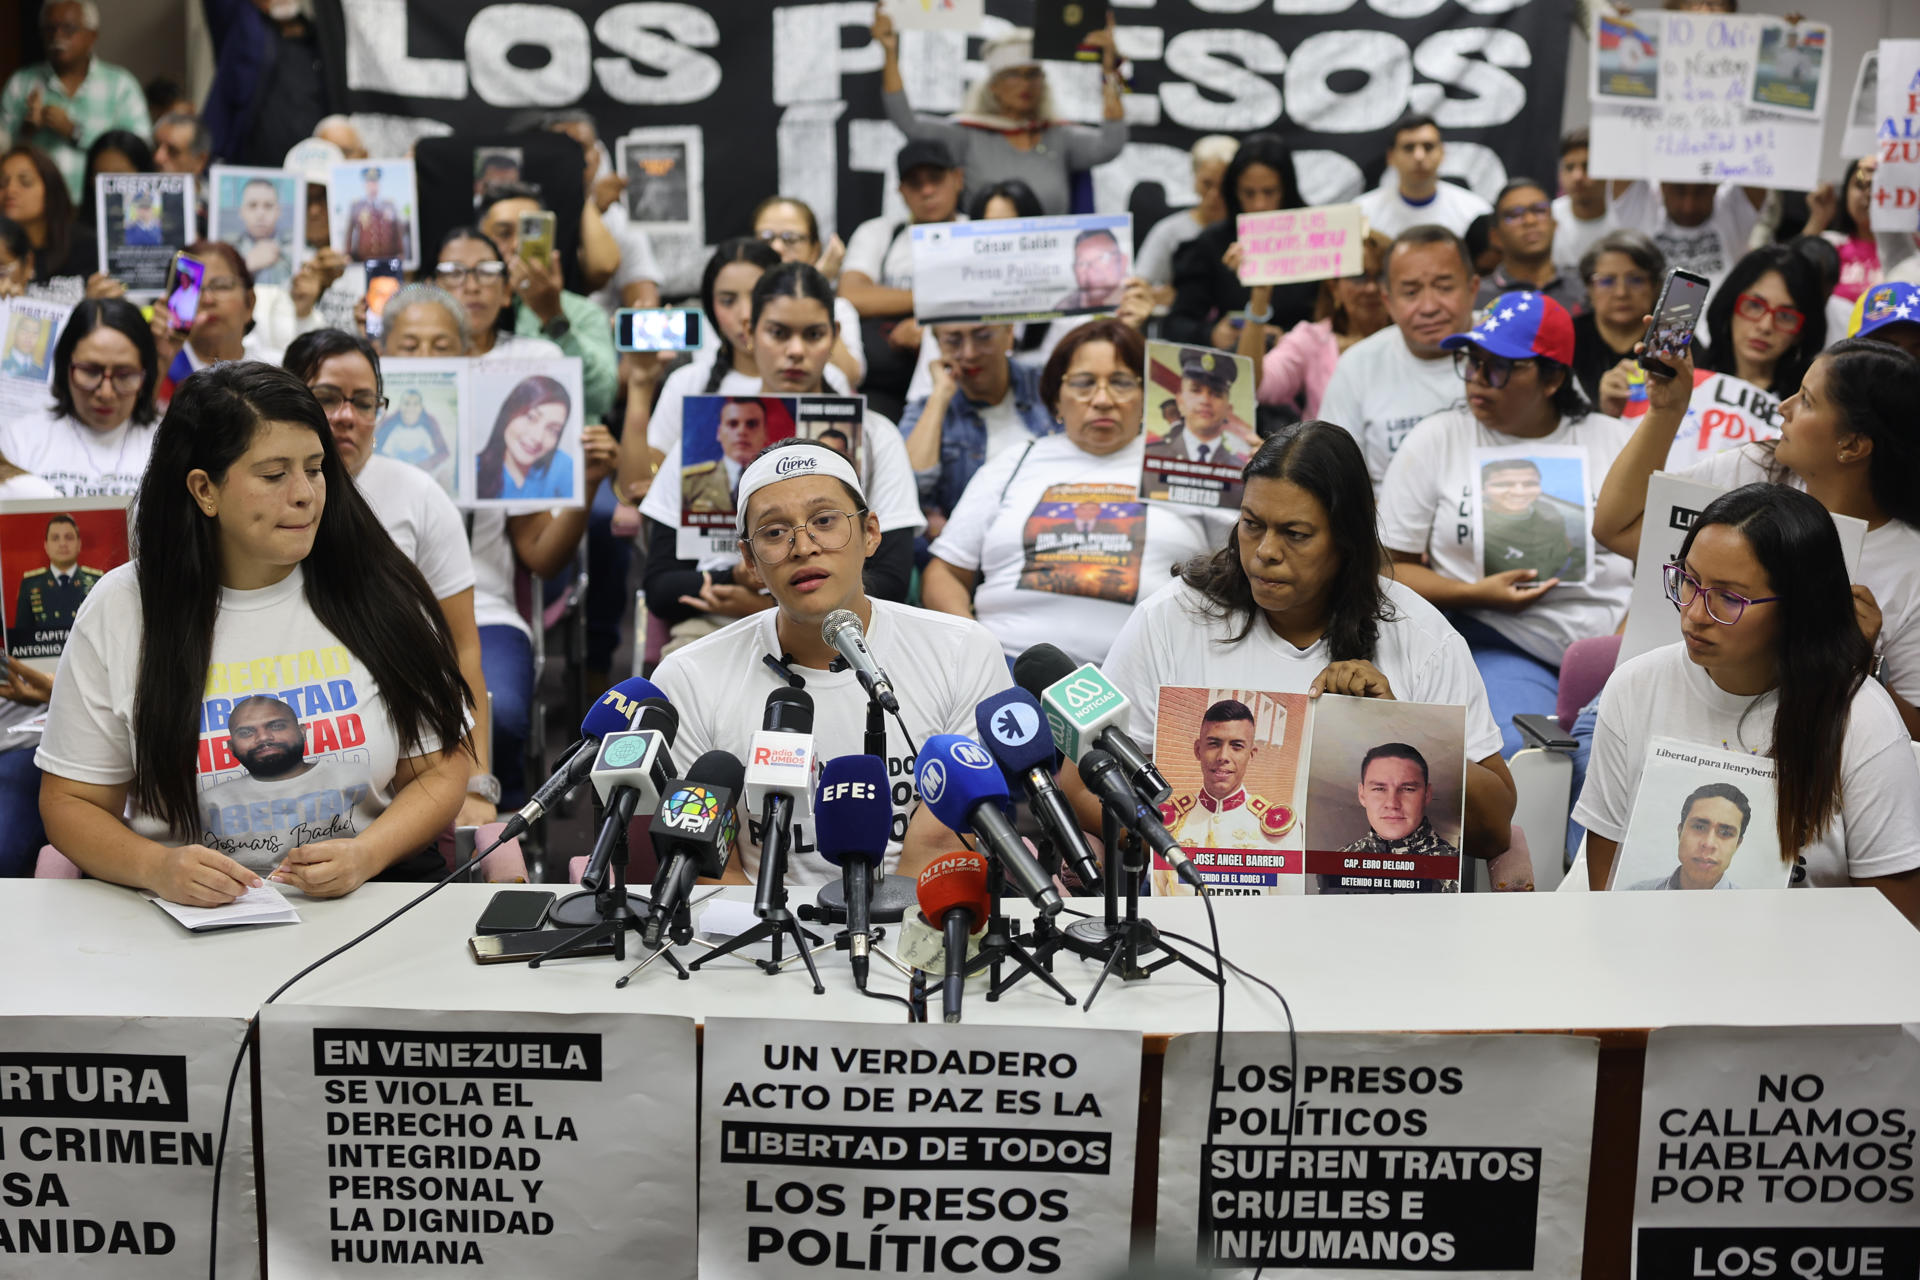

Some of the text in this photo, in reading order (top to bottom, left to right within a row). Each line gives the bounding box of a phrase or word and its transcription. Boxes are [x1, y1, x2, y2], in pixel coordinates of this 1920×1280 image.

[344, 0, 723, 107] LOS
[1168, 485, 1220, 506] LIBERTAD
[12, 645, 61, 656] ANTONIO
[35, 630, 71, 642] CAPITA
[204, 645, 350, 697] BERTAD
[1074, 690, 1116, 720] NOTICIAS
[1656, 748, 1697, 765] Libertad
[1698, 757, 1721, 771] para
[920, 857, 981, 883] NTN24
[1193, 853, 1285, 868] JOSE ANGEL BARRENO
[1344, 858, 1415, 871] CAP. EBRO DELGADO
[1221, 874, 1230, 883] EN
[1231, 875, 1239, 883] EL
[1240, 874, 1261, 884] RODEO
[1261, 875, 1266, 884] 1
[1341, 877, 1420, 889] DETENIDO EN EL RODEO 1
[324, 1041, 587, 1070] EN VENEZUELA
[765, 1044, 1078, 1079] UN VERDADERO
[0, 1065, 171, 1105] RTURA
[325, 1080, 533, 1107] SE VIOLA EL
[1217, 1064, 1463, 1095] LOS PRESOS
[1757, 1074, 1824, 1103] NO
[723, 1082, 1102, 1118] ACTO DE PAZ ES LA
[327, 1112, 578, 1141] DERECHO A LA
[1213, 1101, 1428, 1137] POLÍTICOS
[1659, 1108, 1916, 1146] CALLAMOS,
[20, 1126, 214, 1166] CRIMEN
[328, 1144, 541, 1172] INTEGRIDAD
[727, 1130, 1107, 1166] LIBERTAD DE TODOS
[1658, 1141, 1914, 1171] HABLAMOS
[1211, 1149, 1534, 1182] SUFREN TRATOS
[2, 1172, 70, 1208] SA
[329, 1176, 544, 1204] PERSONAL Y
[746, 1180, 1069, 1222] LOS PRESOS
[1651, 1175, 1915, 1204] POR TODOS
[1211, 1190, 1424, 1220] CRUELES E
[331, 1208, 554, 1236] LA DIGNIDAD
[331, 1239, 484, 1265] HUMANA
[748, 1224, 1062, 1275] POLÍTICOS
[1693, 1247, 1885, 1280] LOS QUE
